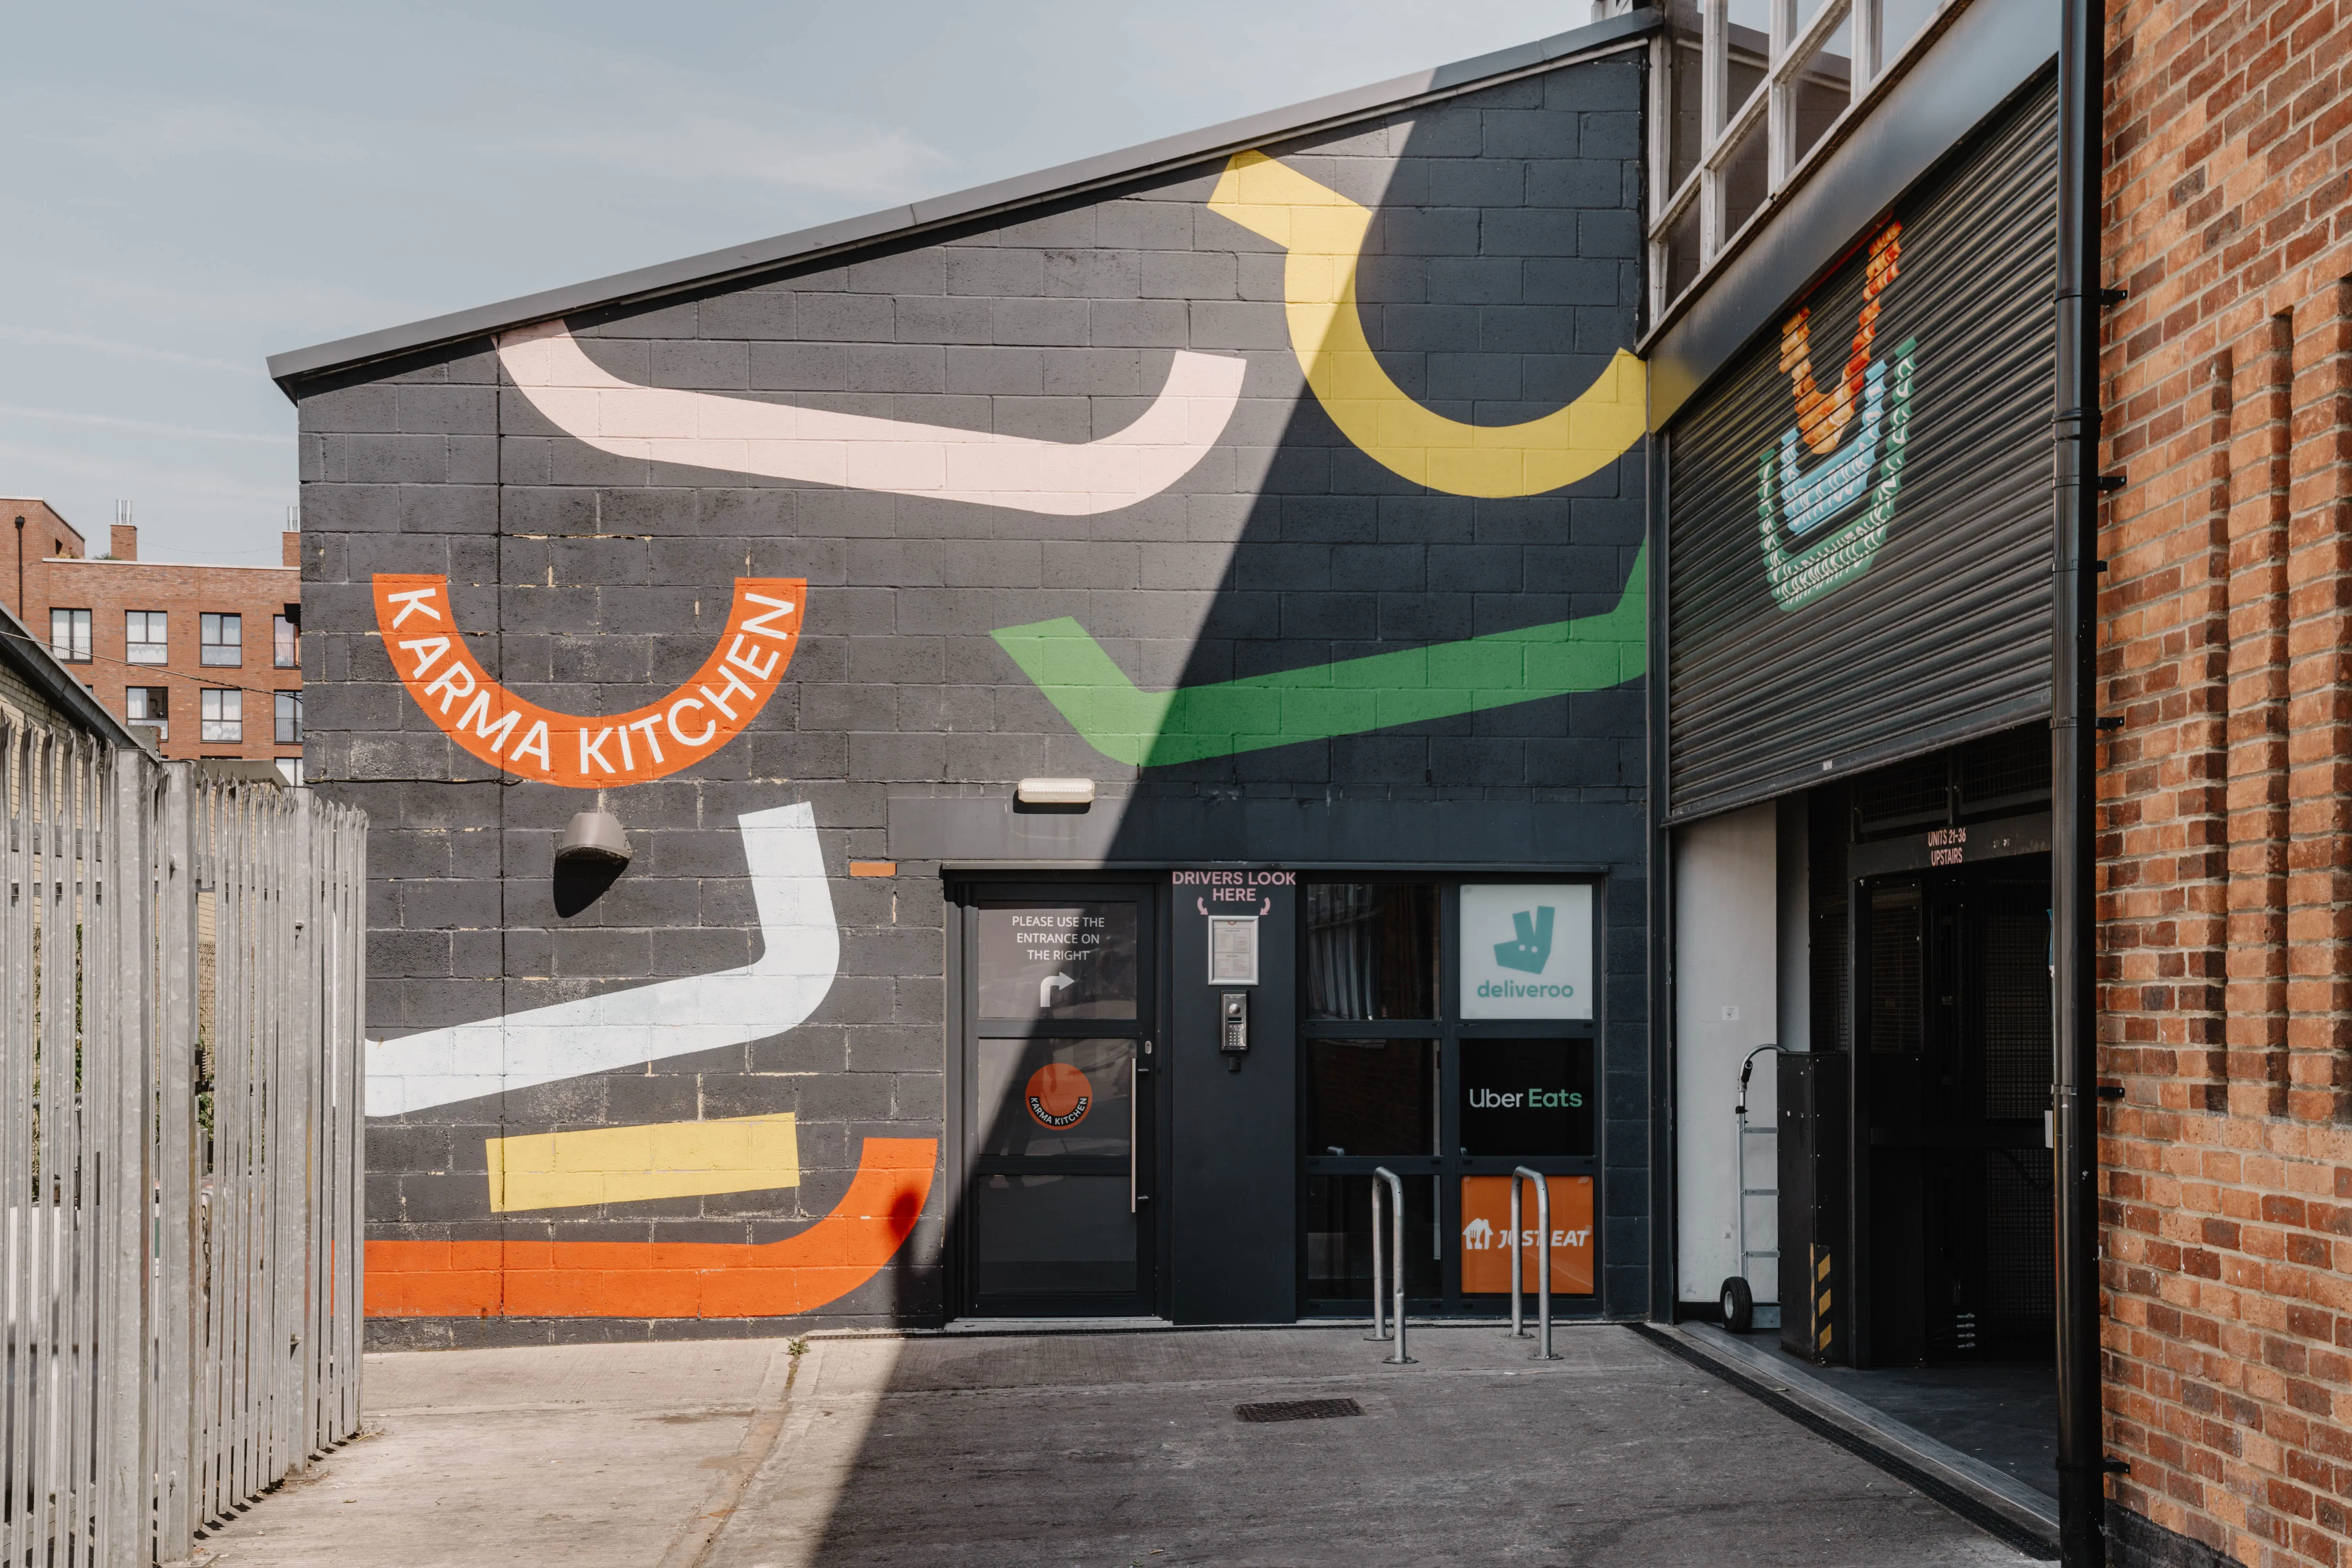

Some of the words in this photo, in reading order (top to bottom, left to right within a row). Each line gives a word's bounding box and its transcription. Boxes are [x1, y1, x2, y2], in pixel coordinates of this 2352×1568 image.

[388, 588, 551, 772] KARMA
[579, 592, 795, 774] KITCHEN
[1928, 829, 1947, 847] UNITS
[1949, 828, 1966, 844] 21-36
[1931, 847, 1962, 866] UPSTAIRS
[1172, 871, 1243, 885] DRIVERS
[1248, 871, 1296, 885] LOOK
[1213, 888, 1256, 901] HERE
[1012, 916, 1054, 926] PLEASE
[1057, 916, 1079, 927] USE
[1082, 917, 1105, 927] THE
[1017, 933, 1078, 944] ENTRANCE
[1081, 934, 1099, 944] ON
[1027, 950, 1050, 960] THE
[1053, 950, 1090, 960] RIGHT
[1477, 980, 1574, 998] deliveroo
[1470, 1089, 1523, 1107] Uber
[1529, 1089, 1583, 1107] Eats
[1031, 1098, 1052, 1123] KARMA
[1054, 1098, 1087, 1125] KITCHEN
[1551, 1230, 1590, 1247] EAT
